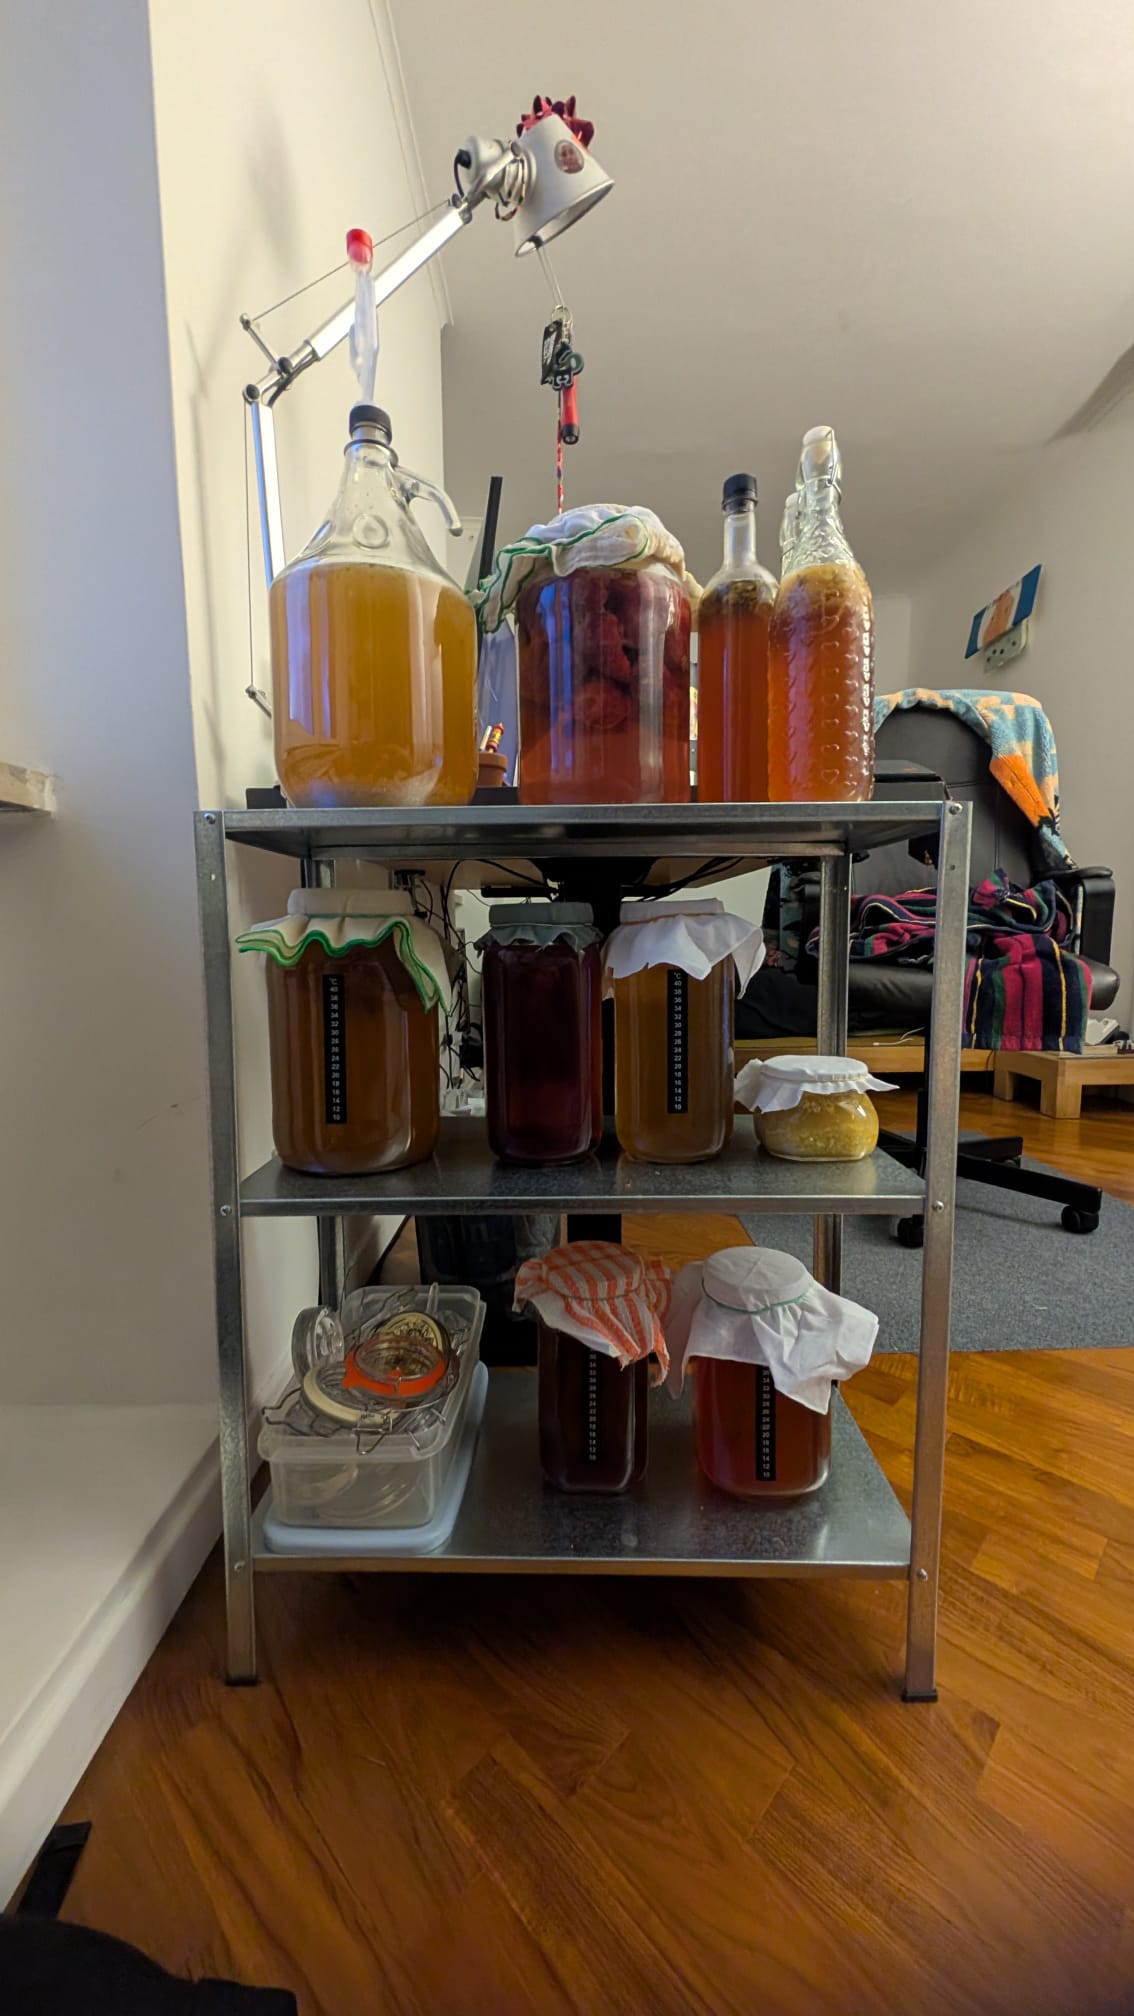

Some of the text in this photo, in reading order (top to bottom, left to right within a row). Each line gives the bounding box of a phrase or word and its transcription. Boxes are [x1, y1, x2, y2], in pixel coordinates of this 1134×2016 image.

[673, 996, 682, 1004] 36
[673, 1046, 682, 1054] 24
[674, 1103, 682, 1111] 10
